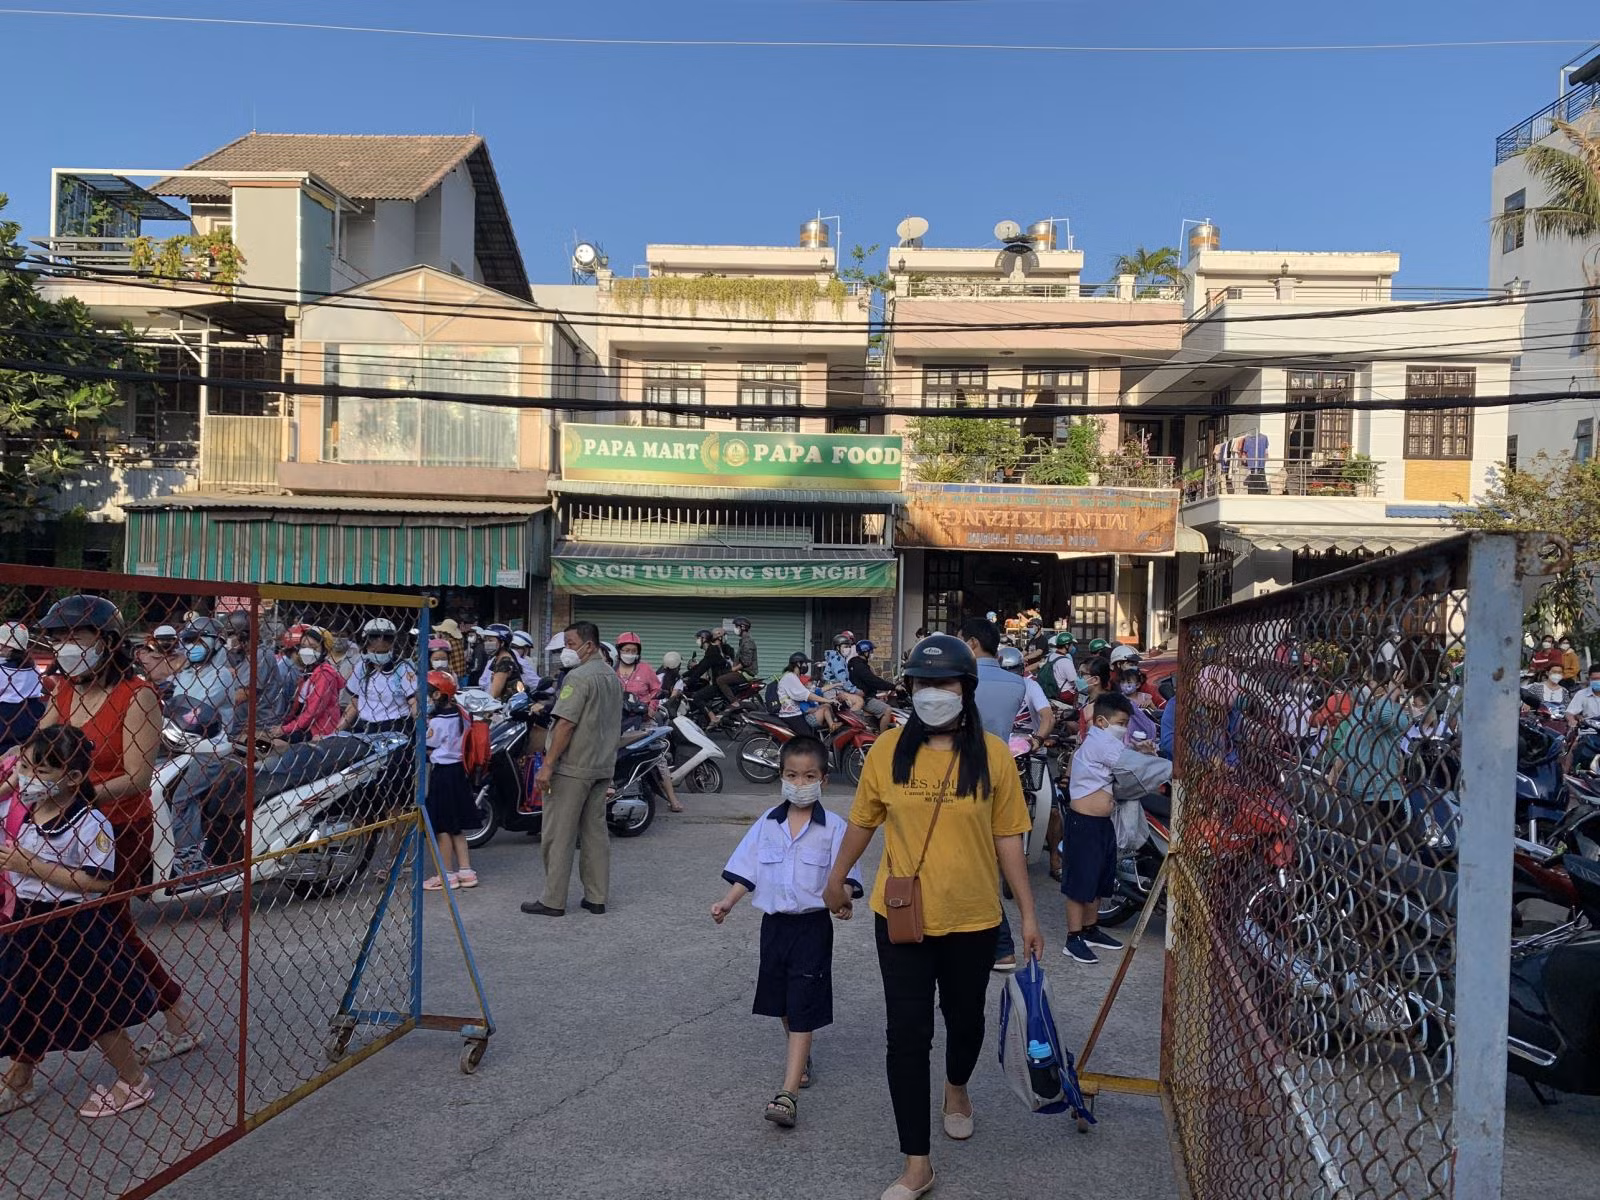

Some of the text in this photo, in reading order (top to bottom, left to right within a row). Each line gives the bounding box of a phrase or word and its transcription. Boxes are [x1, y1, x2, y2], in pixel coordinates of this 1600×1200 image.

[583, 438, 699, 460] PAPA MART
[753, 443, 901, 465] PAPA FOOD
[940, 508, 1129, 531] MINH KHANG
[678, 565, 755, 580] TRONG
[761, 566, 805, 580] SUY
